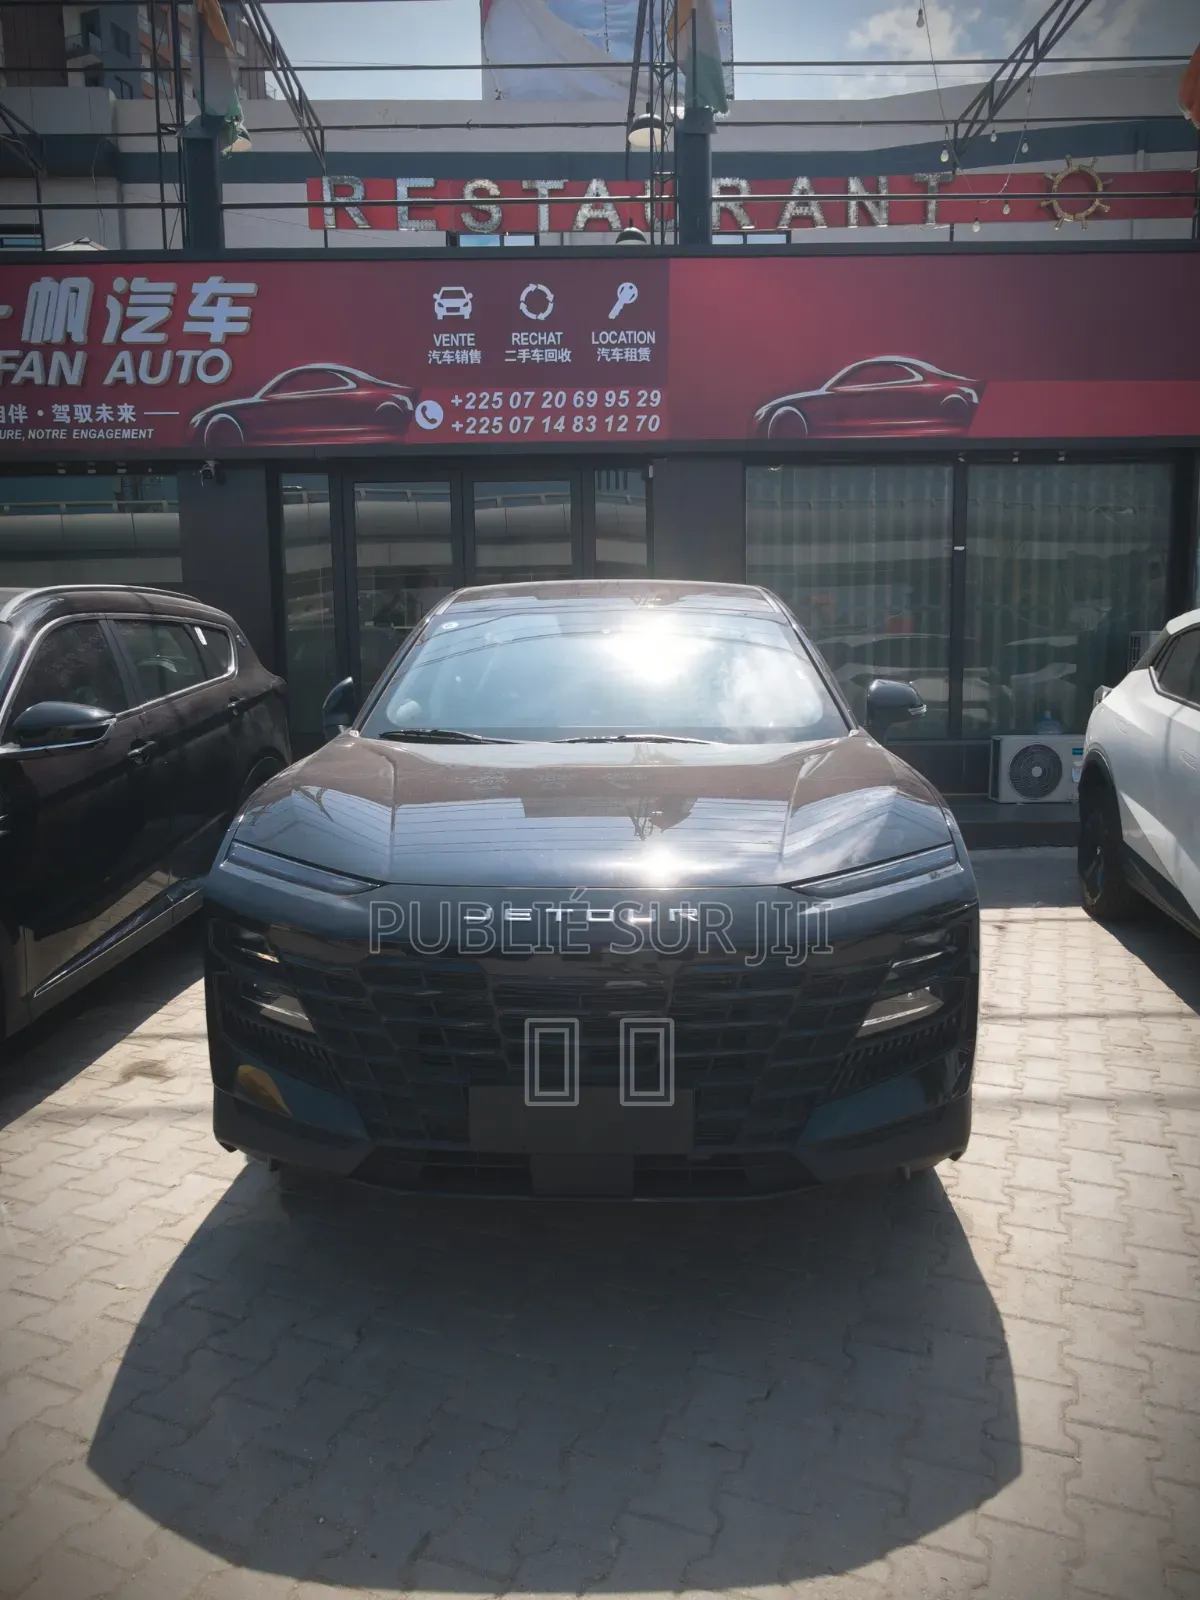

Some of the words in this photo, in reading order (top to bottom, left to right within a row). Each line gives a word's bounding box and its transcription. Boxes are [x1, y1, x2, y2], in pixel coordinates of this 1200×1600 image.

[0, 276, 259, 345] 帆汽车
[433, 333, 476, 347] VENTE
[511, 332, 563, 346] RECHAT
[591, 331, 656, 345] LOCATION
[428, 350, 482, 365] 汽车销售
[504, 349, 572, 363] 二手车回收
[597, 348, 651, 363] 汽车租赁
[103, 349, 233, 386] AUTO
[451, 391, 504, 410] +225
[509, 391, 536, 409] 07
[541, 391, 567, 409] 20
[572, 390, 598, 408] 69
[604, 390, 630, 408] 95
[636, 390, 662, 408] 29
[451, 416, 504, 435] +225
[509, 416, 535, 434] 07
[541, 416, 566, 433] 14
[572, 416, 597, 433] 83
[605, 415, 629, 433] 12
[636, 415, 661, 432] 70
[28, 429, 67, 439] NOTRE
[72, 428, 154, 439] ENGAGEMENT
[463, 907, 699, 923] JETOUR
